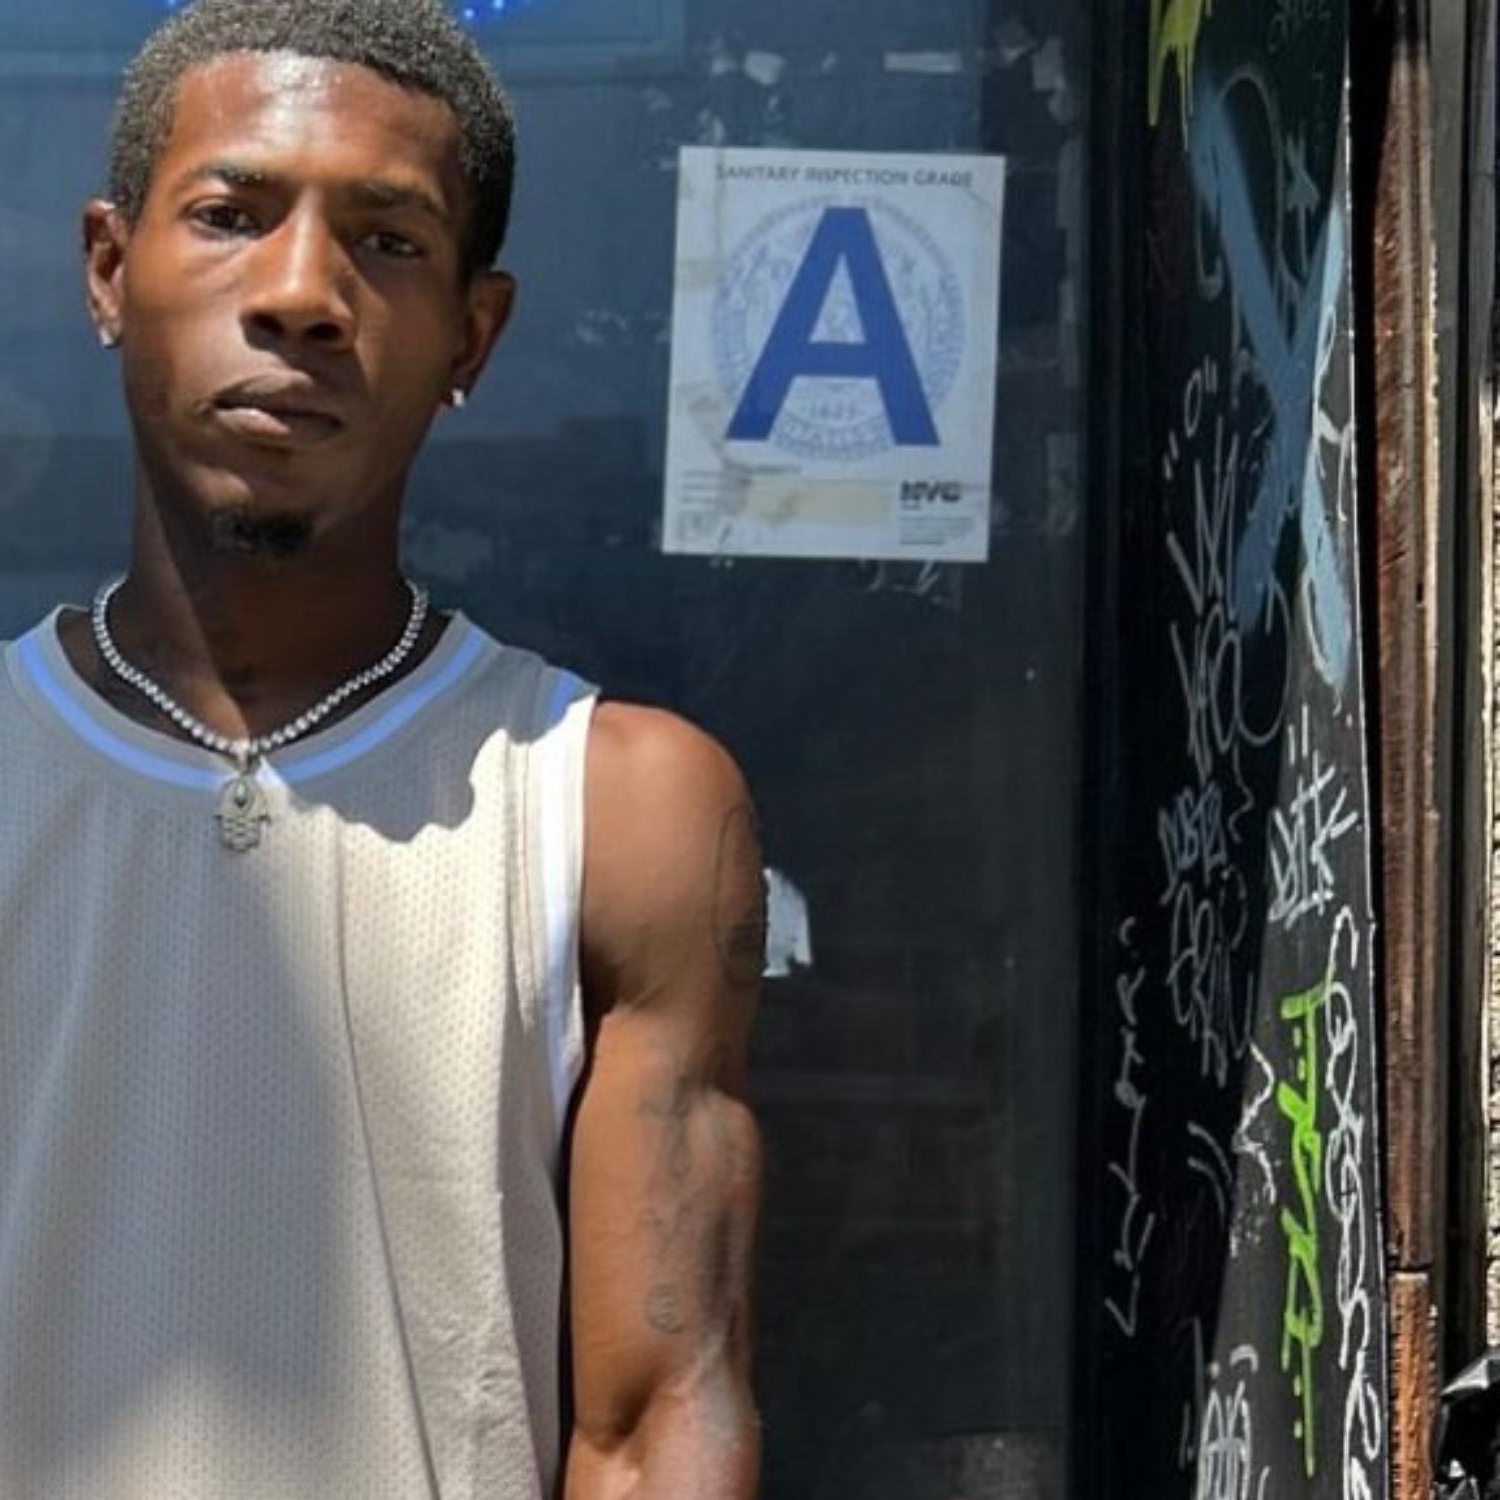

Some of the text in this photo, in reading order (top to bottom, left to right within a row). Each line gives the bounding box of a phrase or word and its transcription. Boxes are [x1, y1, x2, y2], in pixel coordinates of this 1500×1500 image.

[716, 164, 973, 189] SANITARY INSPECTION GRADE
[725, 207, 941, 447] A
[901, 480, 962, 503] NYC
